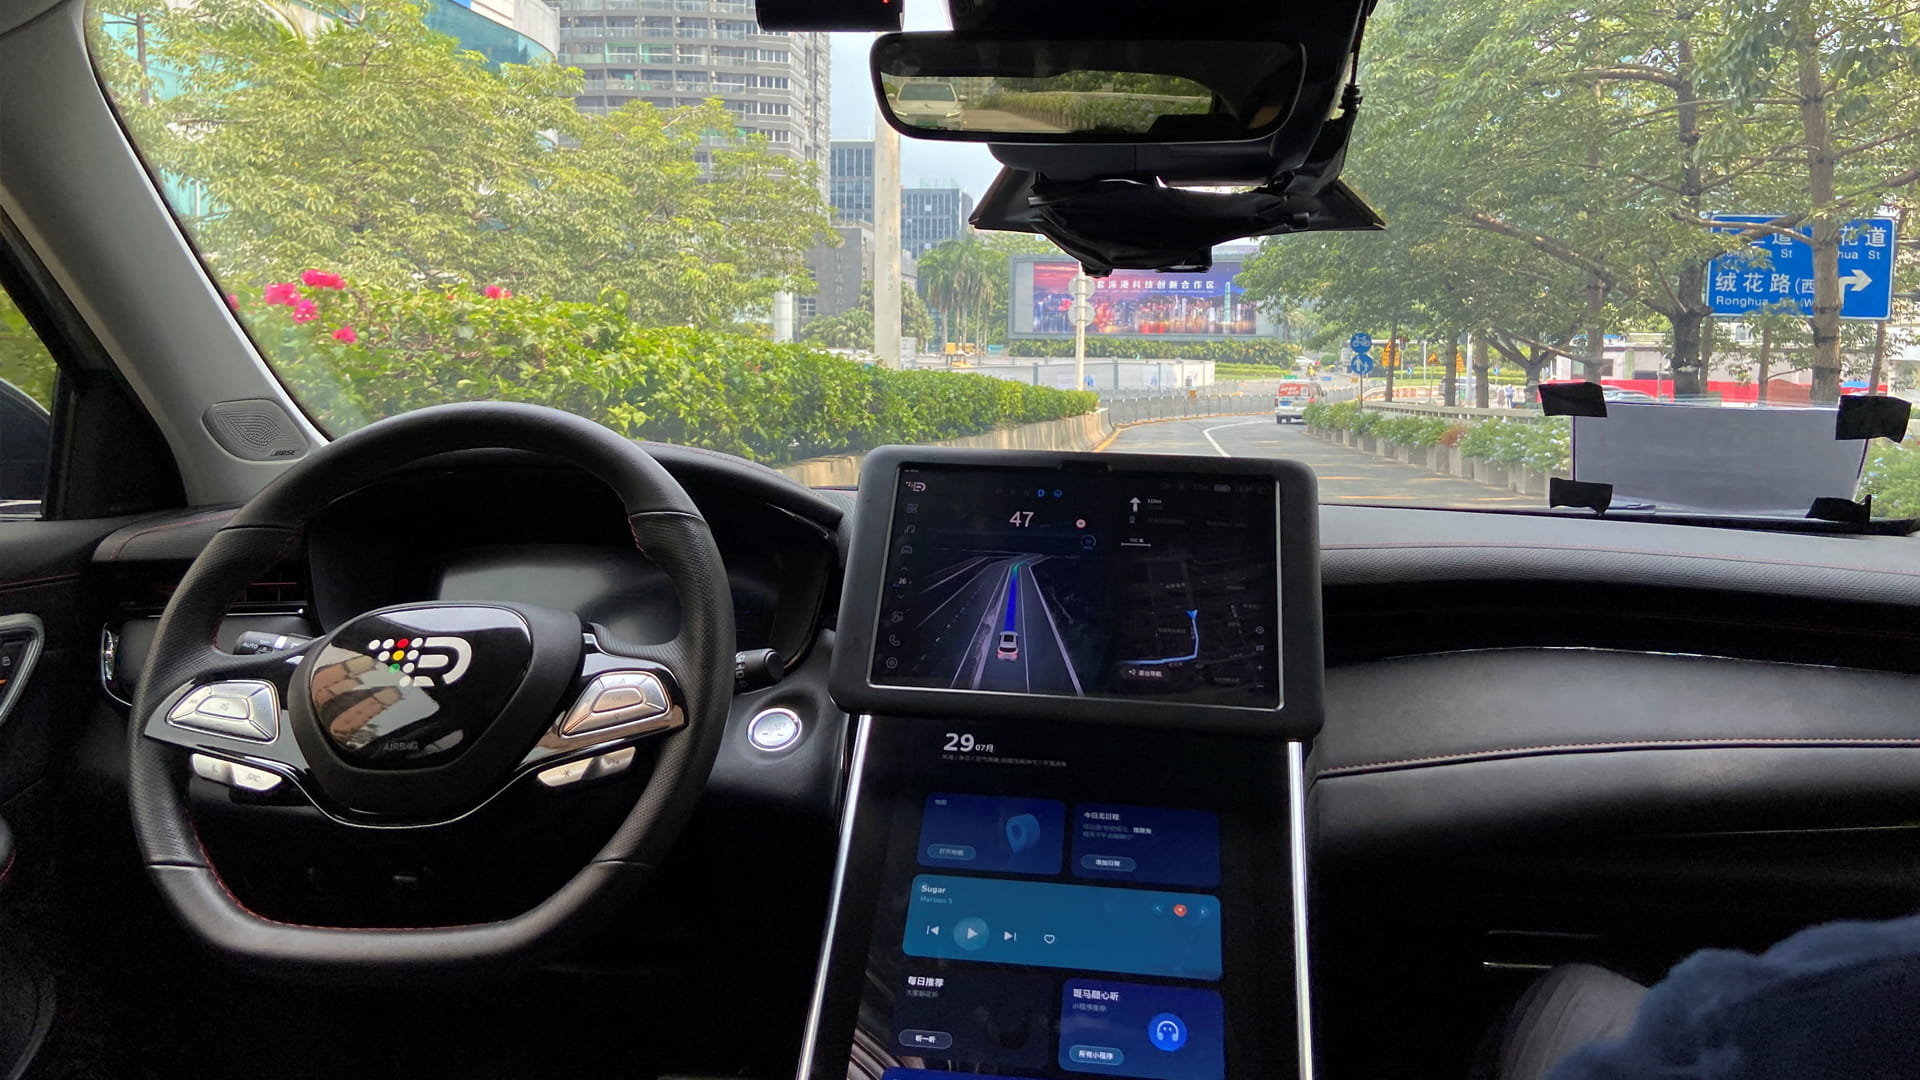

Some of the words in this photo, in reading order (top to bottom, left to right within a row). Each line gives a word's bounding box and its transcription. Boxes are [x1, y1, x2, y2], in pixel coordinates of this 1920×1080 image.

[1780, 248, 1793, 259] St
[1838, 250, 1859, 260] hua
[1868, 250, 1880, 260] St
[1009, 511, 1034, 528] 47
[383, 741, 418, 752] AIRBAG
[943, 733, 974, 752] 29
[975, 743, 994, 752] 07月
[921, 884, 946, 895] Sugar
[907, 976, 944, 988] 每日推荐
[915, 1034, 936, 1044] 听一听
